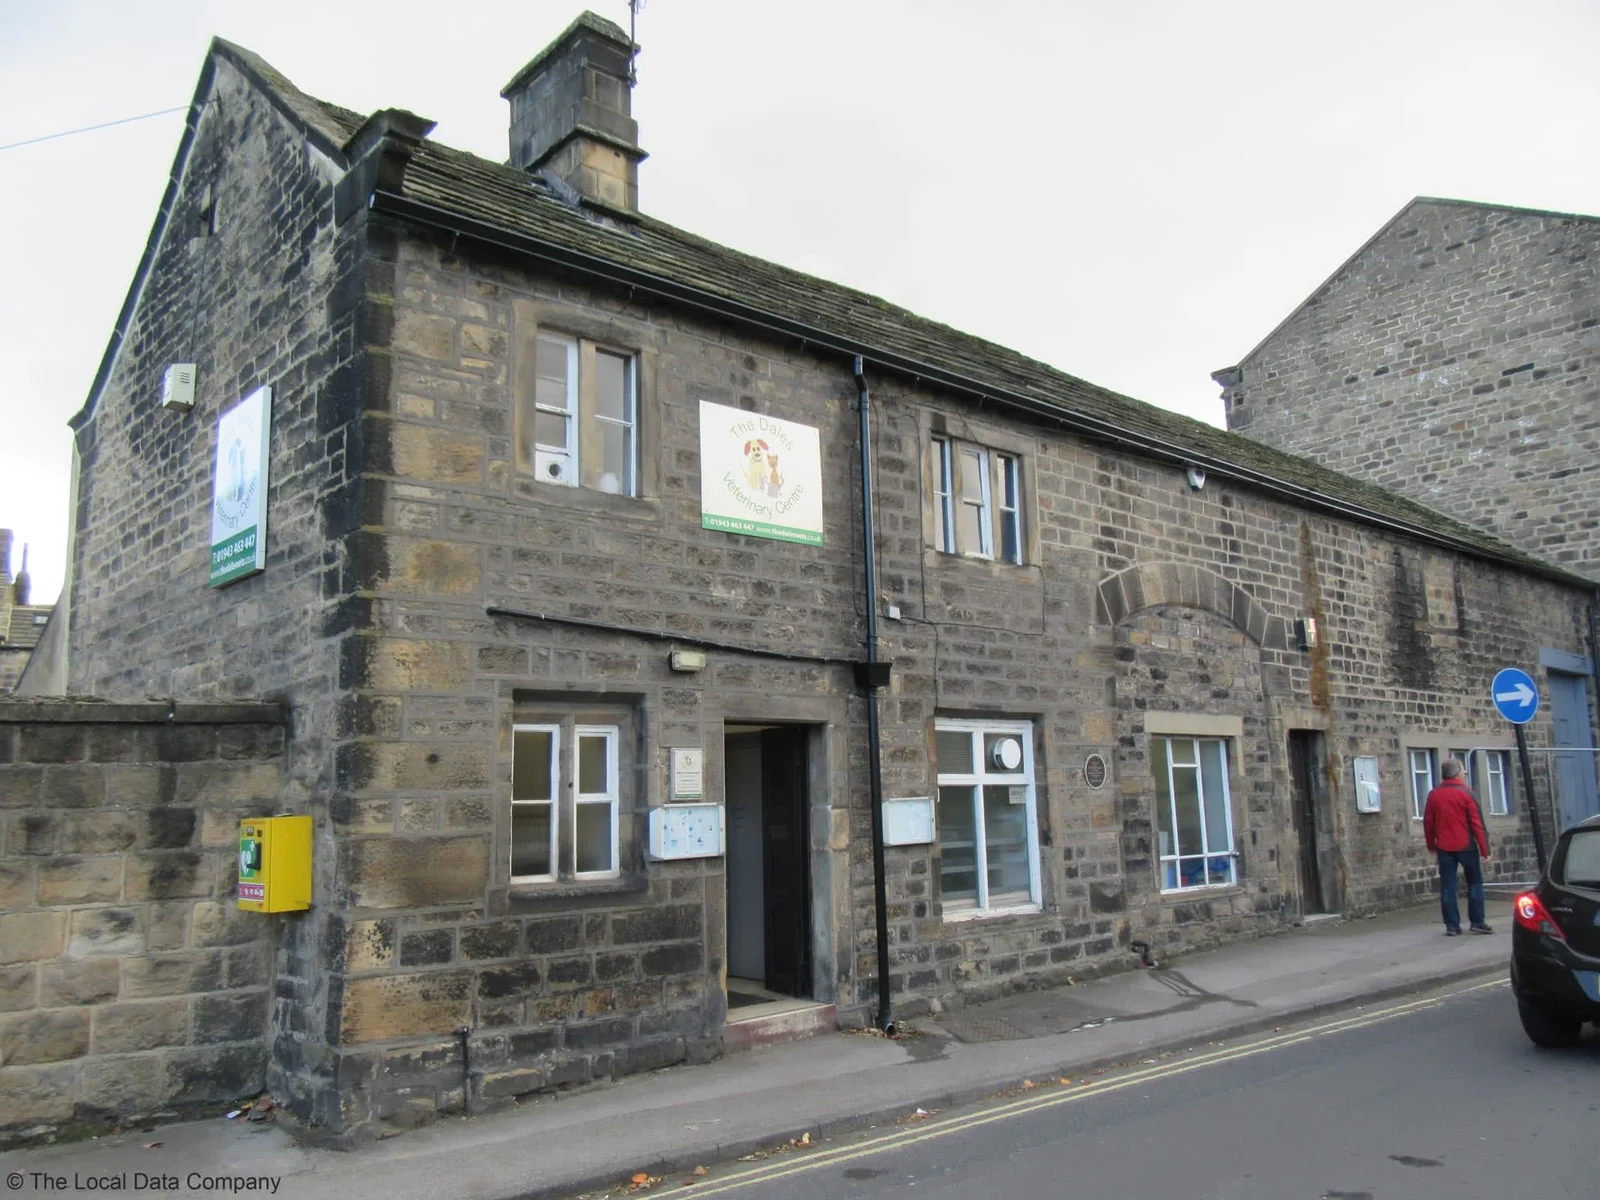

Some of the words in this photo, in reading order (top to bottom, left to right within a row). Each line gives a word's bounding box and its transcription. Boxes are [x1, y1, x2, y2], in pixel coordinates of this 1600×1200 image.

[730, 419, 755, 438] The
[759, 417, 794, 451] Dales
[723, 470, 773, 521] Veterinary
[775, 483, 804, 515] Centre
[731, 523, 742, 531] 463
[233, 539, 244, 554] 463
[244, 534, 256, 549] 447
